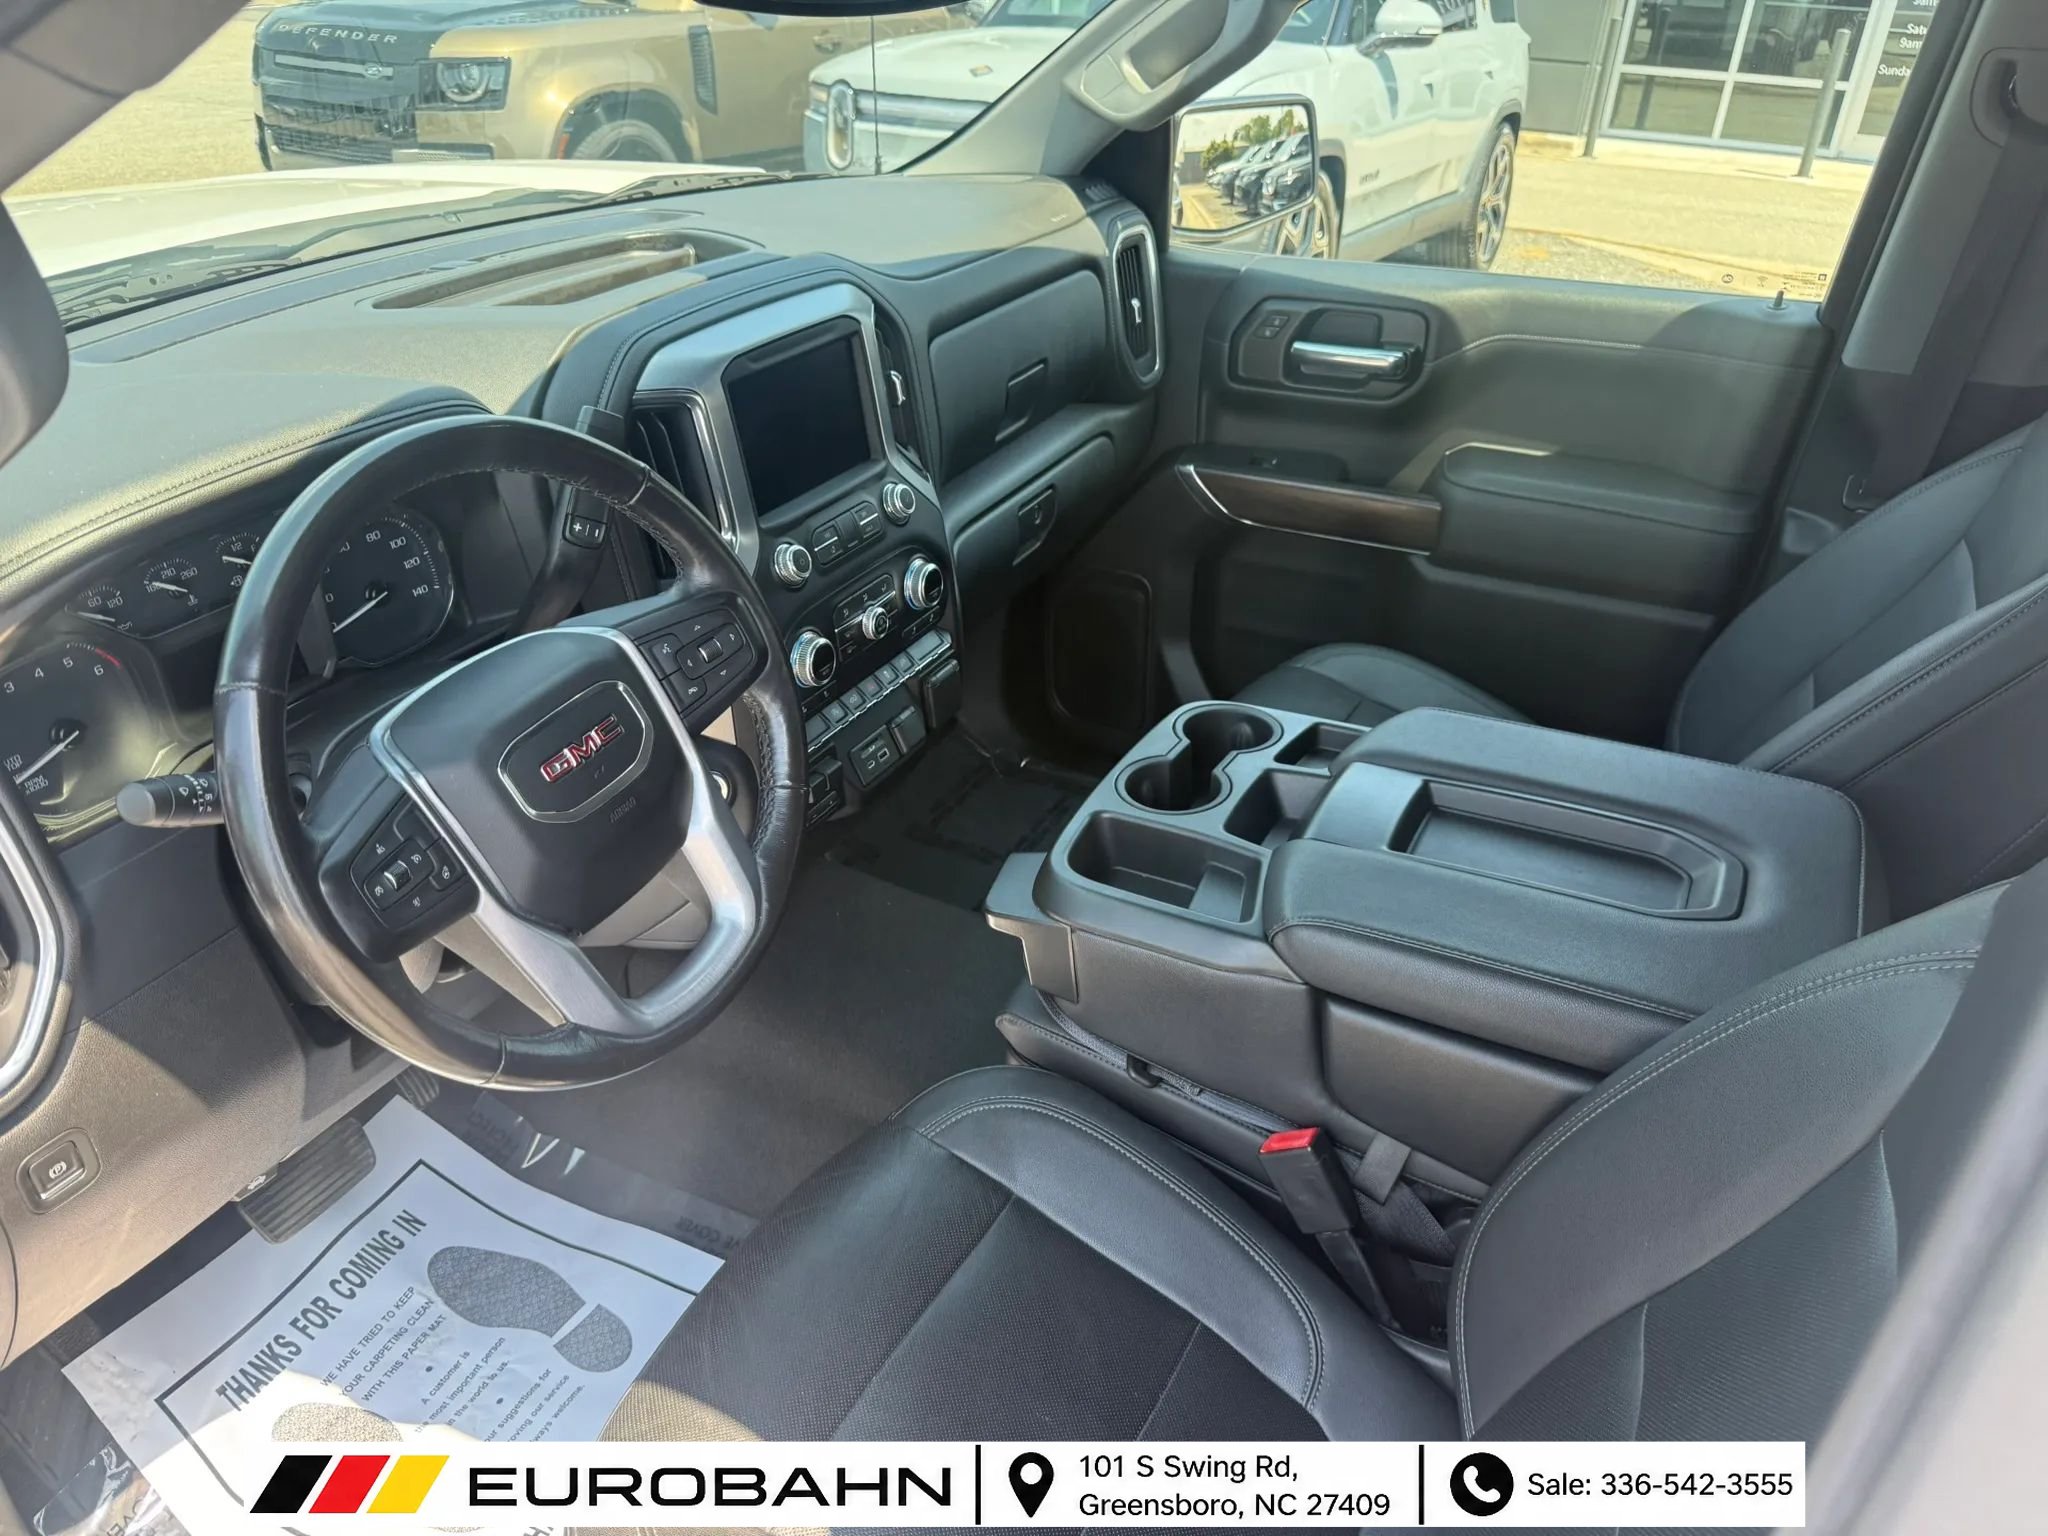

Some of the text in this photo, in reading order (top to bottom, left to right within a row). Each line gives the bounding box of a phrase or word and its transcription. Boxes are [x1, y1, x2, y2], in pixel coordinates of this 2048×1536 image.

[280, 24, 398, 43] DEFENDER
[365, 530, 381, 543] 80
[389, 536, 407, 550] 100
[403, 556, 421, 569] 120
[160, 567, 176, 580] 210
[180, 567, 199, 581] 260
[412, 584, 429, 597] 140
[87, 596, 102, 608] 60
[107, 595, 124, 609] 120
[62, 656, 74, 668] 5
[94, 664, 104, 676] 6
[34, 667, 45, 679] 4
[4, 681, 15, 694] 3
[541, 713, 625, 784] GMC
[215, 1209, 427, 1411] THANKS FOR COMING IN
[320, 1286, 415, 1387] WE HAVE TRIED TO KEEP
[339, 1298, 434, 1397] YOUR CARPETING CLEAN
[361, 1314, 447, 1402] WITH THIS PAPER MAT
[421, 1351, 470, 1406] A customer is
[429, 1401, 450, 1420] most
[447, 1364, 483, 1400] important
[481, 1337, 506, 1364] person
[454, 1404, 469, 1417] the
[468, 1381, 489, 1403] world
[487, 1373, 498, 1381] to
[497, 1360, 510, 1372] us.
[531, 1403, 545, 1417] our
[544, 1374, 570, 1402] service
[498, 1382, 541, 1429] suggestions
[538, 1368, 552, 1383] for
[552, 1385, 586, 1419] welcome.
